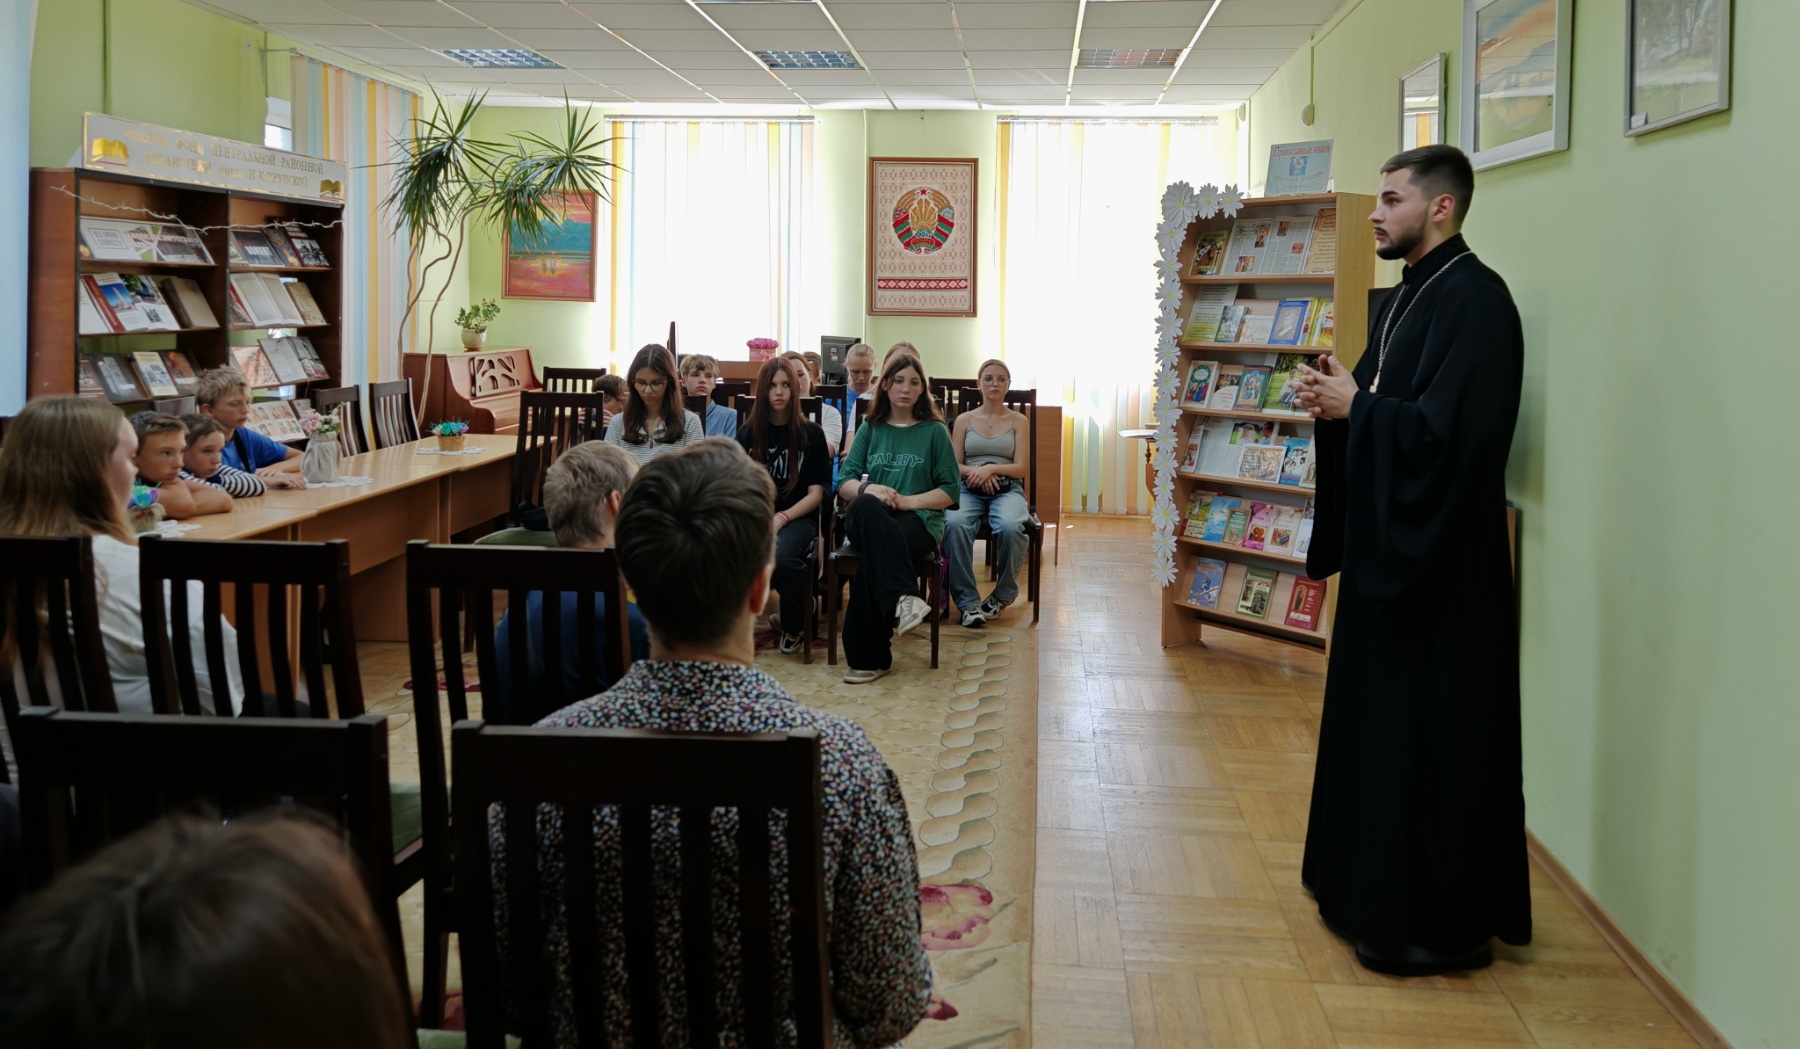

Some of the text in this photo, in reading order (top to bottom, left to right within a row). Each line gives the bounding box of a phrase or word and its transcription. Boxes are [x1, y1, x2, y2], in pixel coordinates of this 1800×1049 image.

[176, 138, 205, 156] ФОНД
[210, 143, 277, 167] ЦЕНТРАЛЬНОЙ
[281, 157, 324, 175] РАЙОННОЙ
